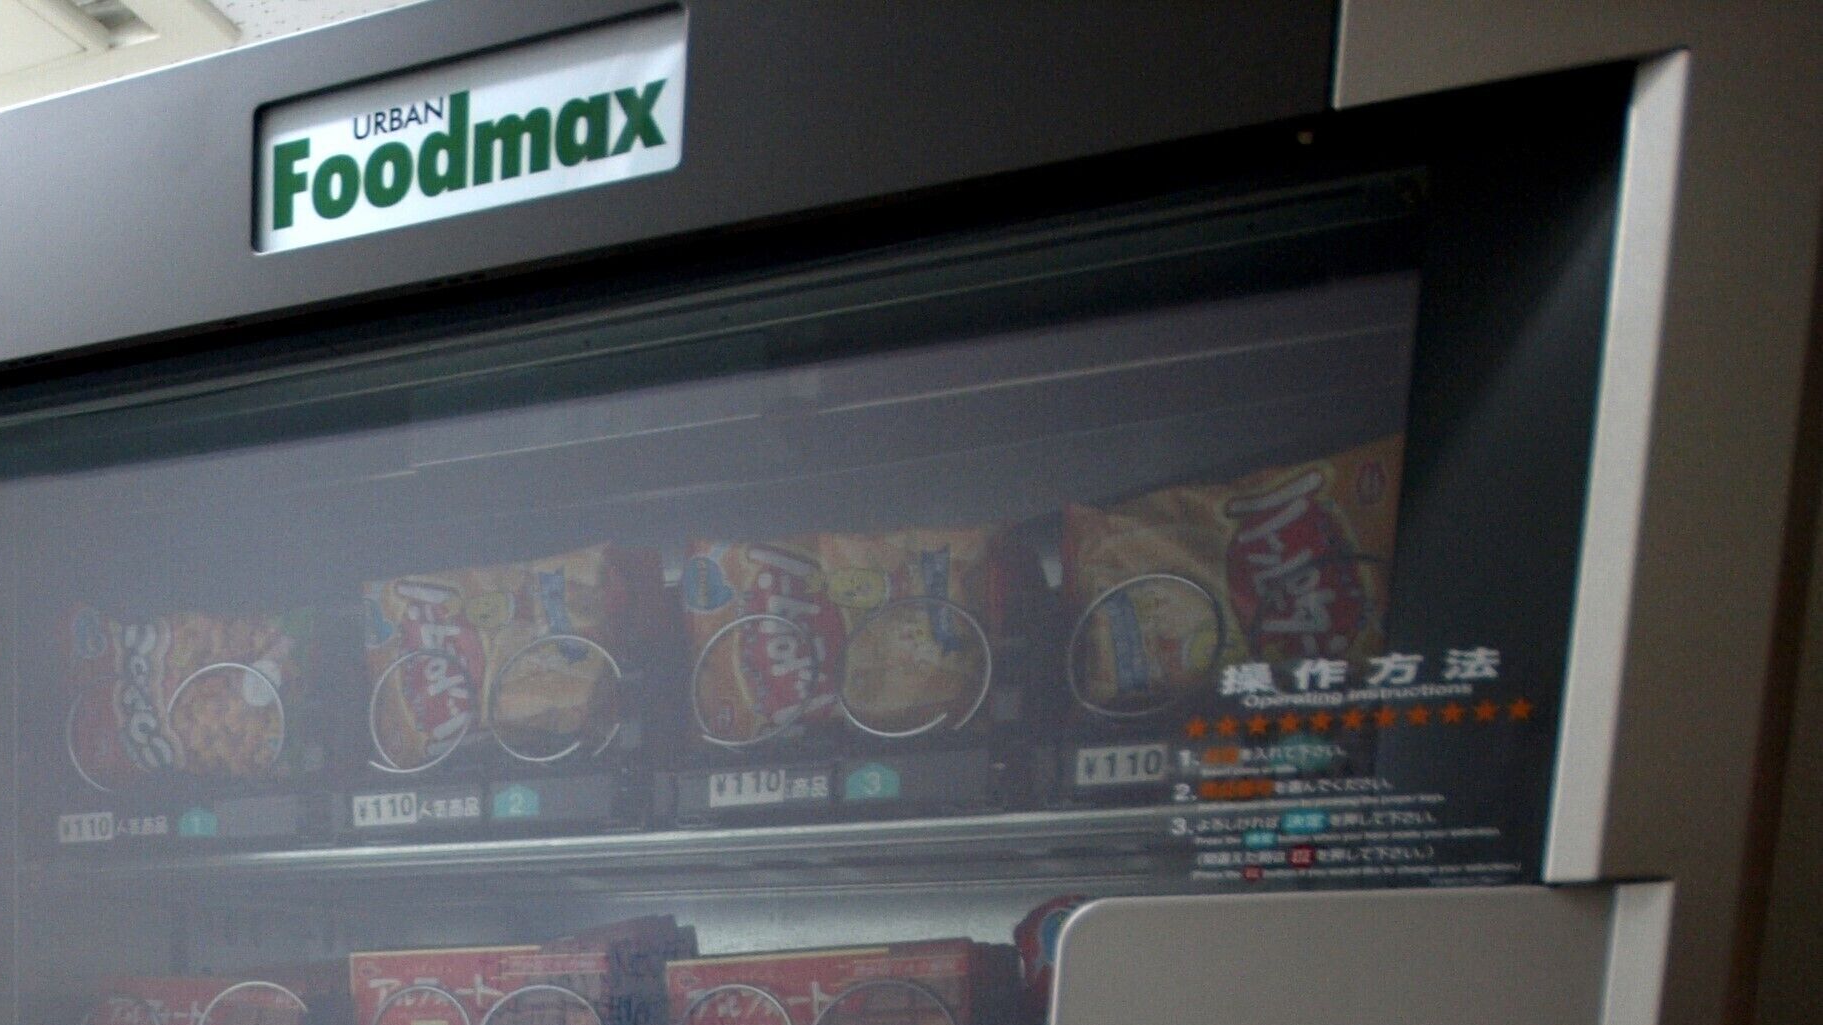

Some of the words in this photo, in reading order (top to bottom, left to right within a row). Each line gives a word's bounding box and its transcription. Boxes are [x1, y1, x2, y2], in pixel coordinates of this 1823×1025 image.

[352, 96, 445, 140] URBAN
[272, 78, 668, 230] Foodmax
[1220, 647, 1500, 695] 操作方法
[1085, 750, 1162, 779] ¥110
